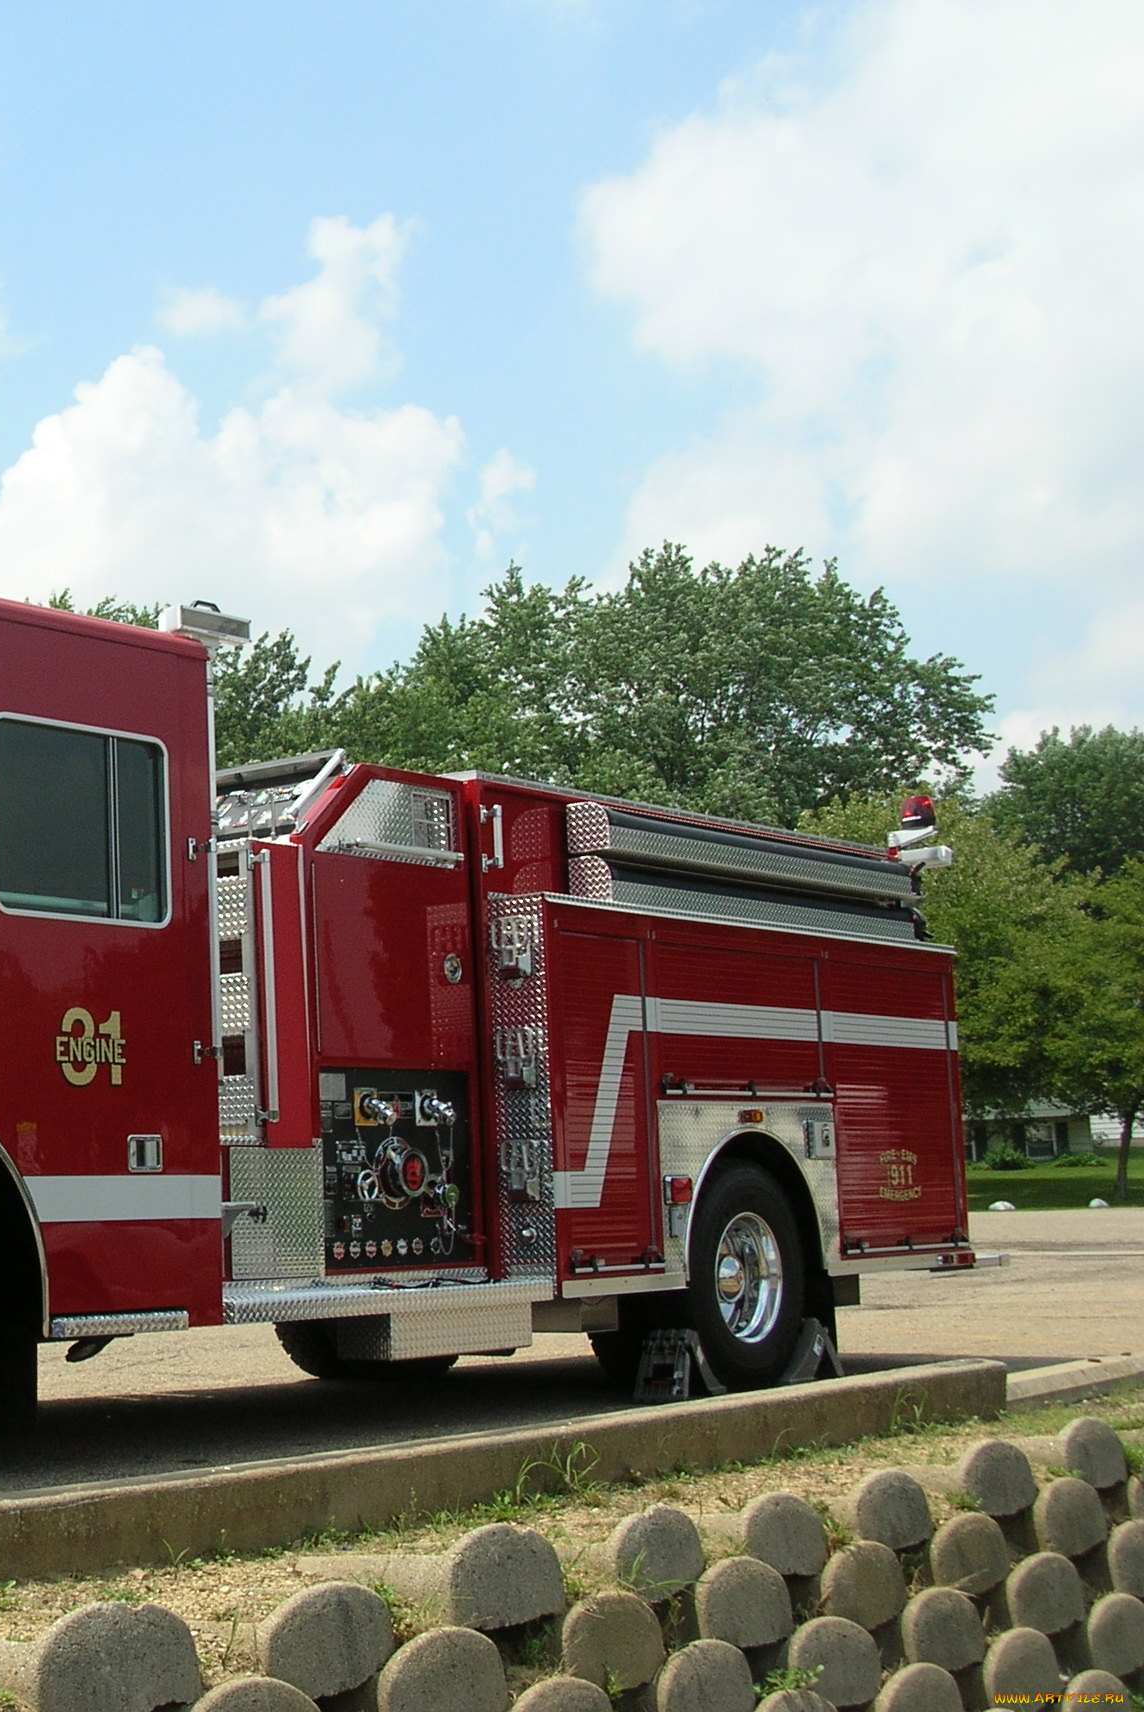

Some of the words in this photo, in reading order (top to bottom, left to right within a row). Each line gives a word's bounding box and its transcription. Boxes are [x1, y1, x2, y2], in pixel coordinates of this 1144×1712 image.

[55, 1036, 127, 1065] ENGINE
[61, 1006, 123, 1087] 31
[890, 1164, 913, 1185] 911
[879, 1186, 922, 1201] EMERGENCY
